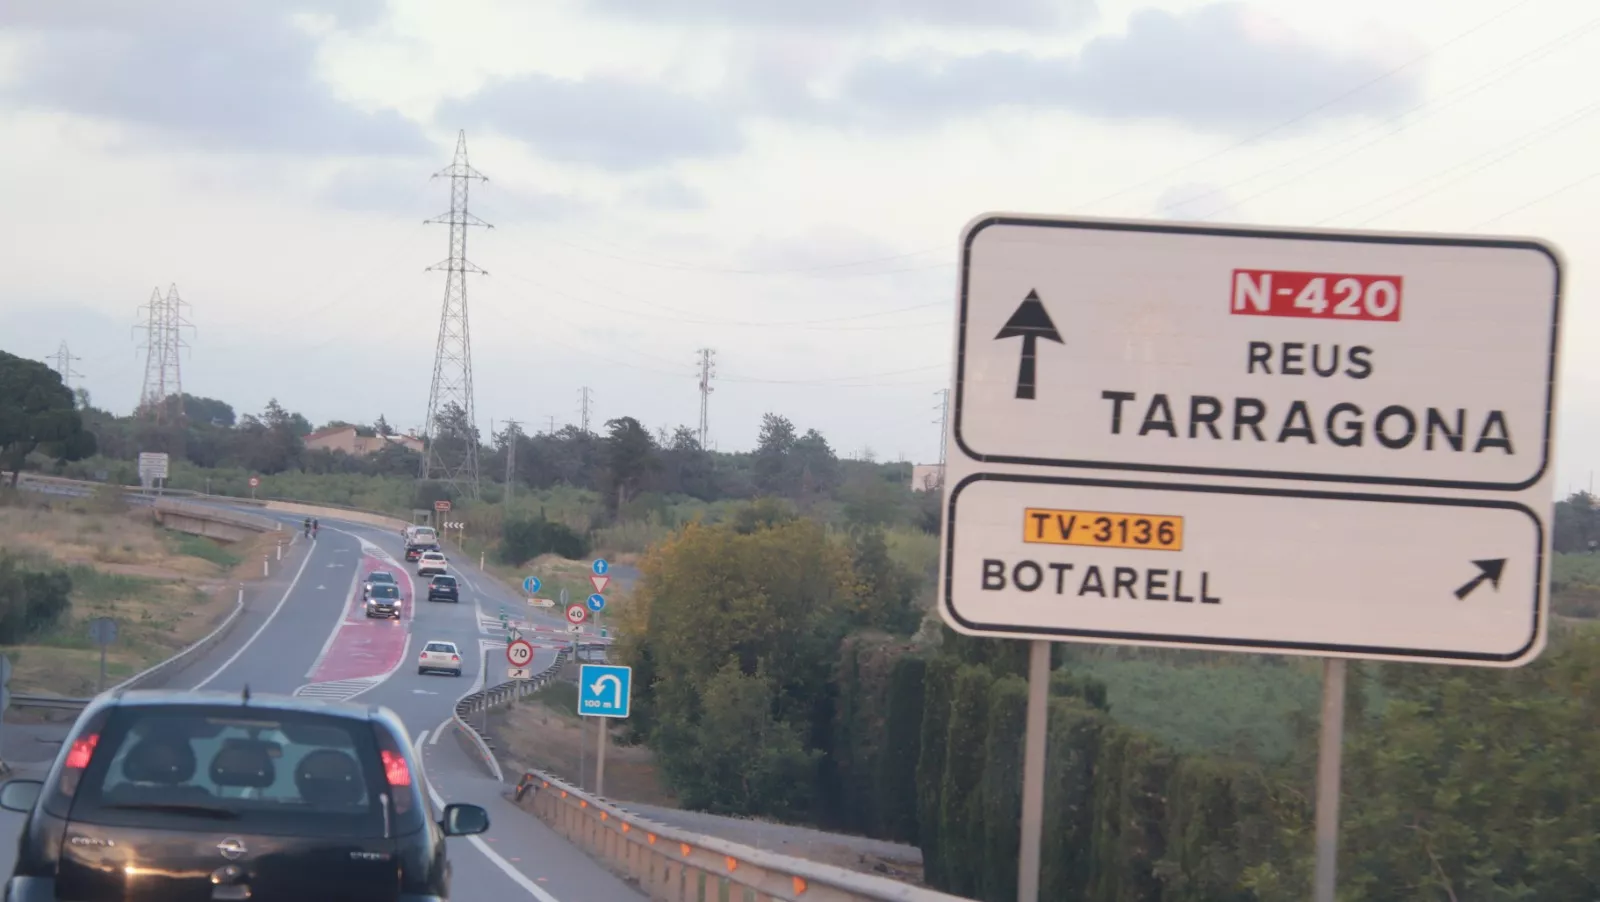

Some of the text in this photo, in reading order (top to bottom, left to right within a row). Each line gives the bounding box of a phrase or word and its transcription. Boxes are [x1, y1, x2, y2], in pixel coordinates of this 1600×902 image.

[1234, 272, 1398, 317] N-420
[1247, 341, 1374, 379] REUS
[1101, 390, 1516, 455] TARRAGONA
[1031, 512, 1175, 545] TV-3136
[981, 559, 1221, 604] BOTARELL
[570, 610, 583, 618] 40
[513, 649, 528, 658] 70
[584, 700, 601, 708] 100
